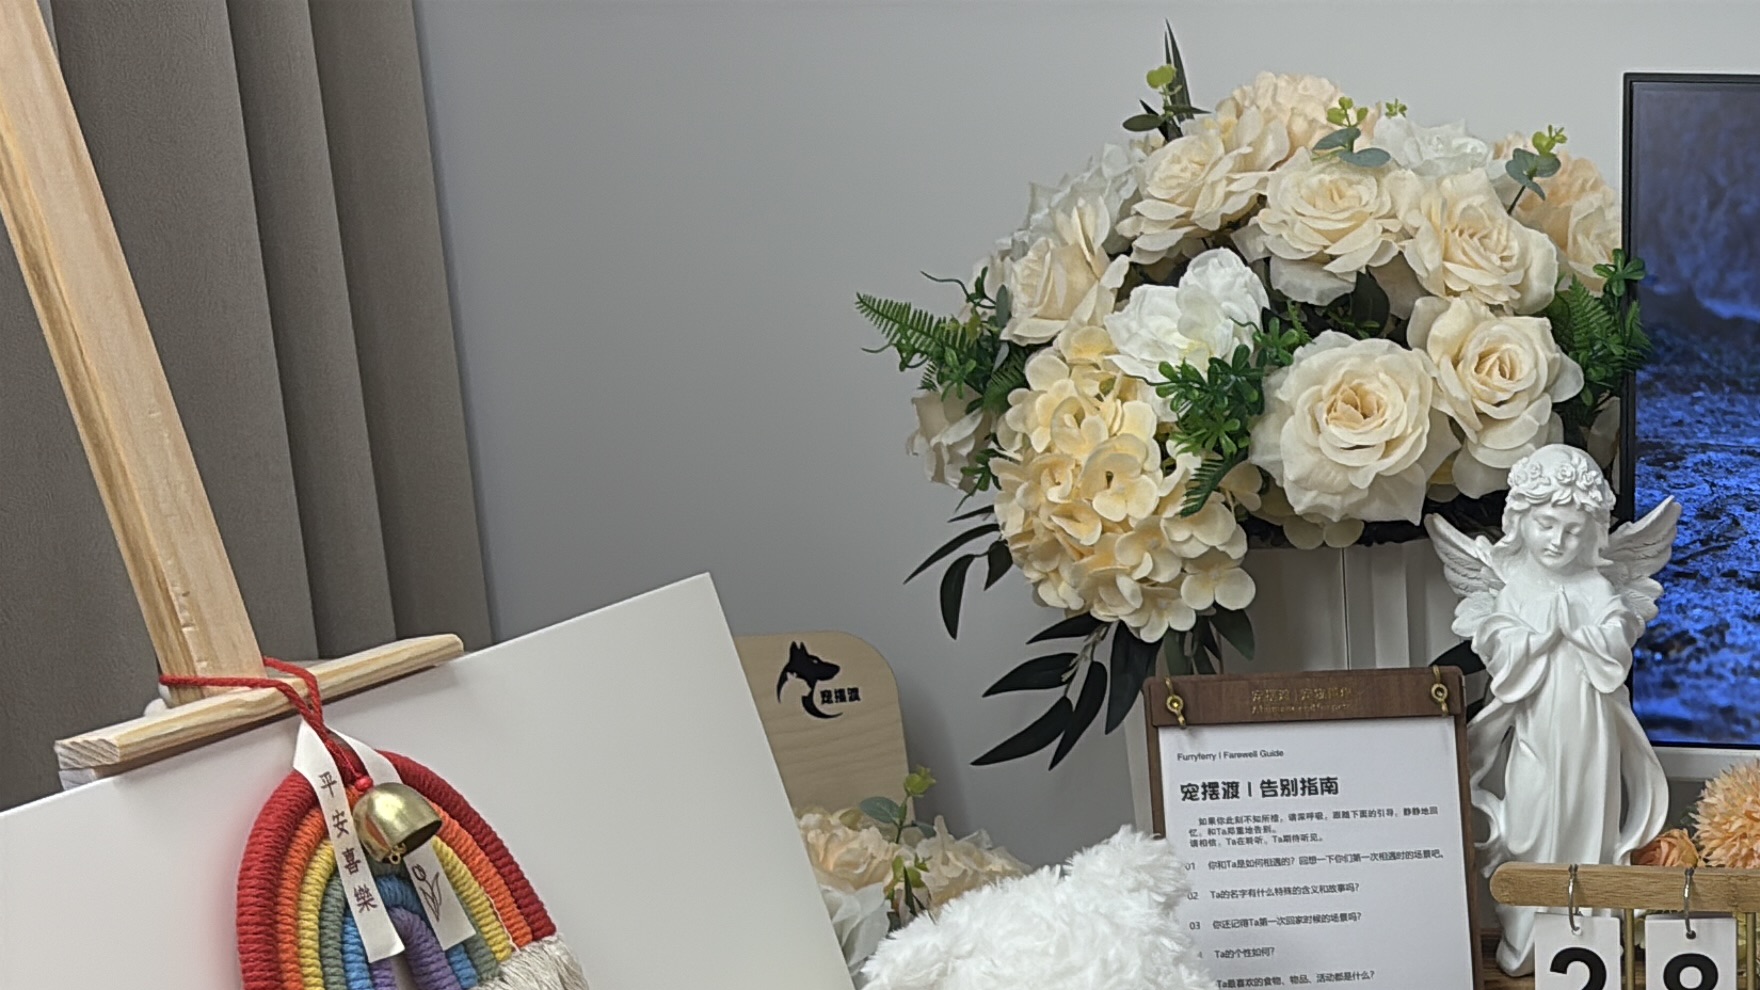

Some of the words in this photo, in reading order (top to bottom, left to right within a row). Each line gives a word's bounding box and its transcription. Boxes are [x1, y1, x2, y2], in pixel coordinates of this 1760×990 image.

[1224, 750, 1258, 759] Farewell
[1259, 749, 1284, 758] Guide
[1180, 780, 1240, 801] 宠摆渡
[1260, 776, 1339, 798] 告别指南
[1189, 921, 1200, 930] 03
